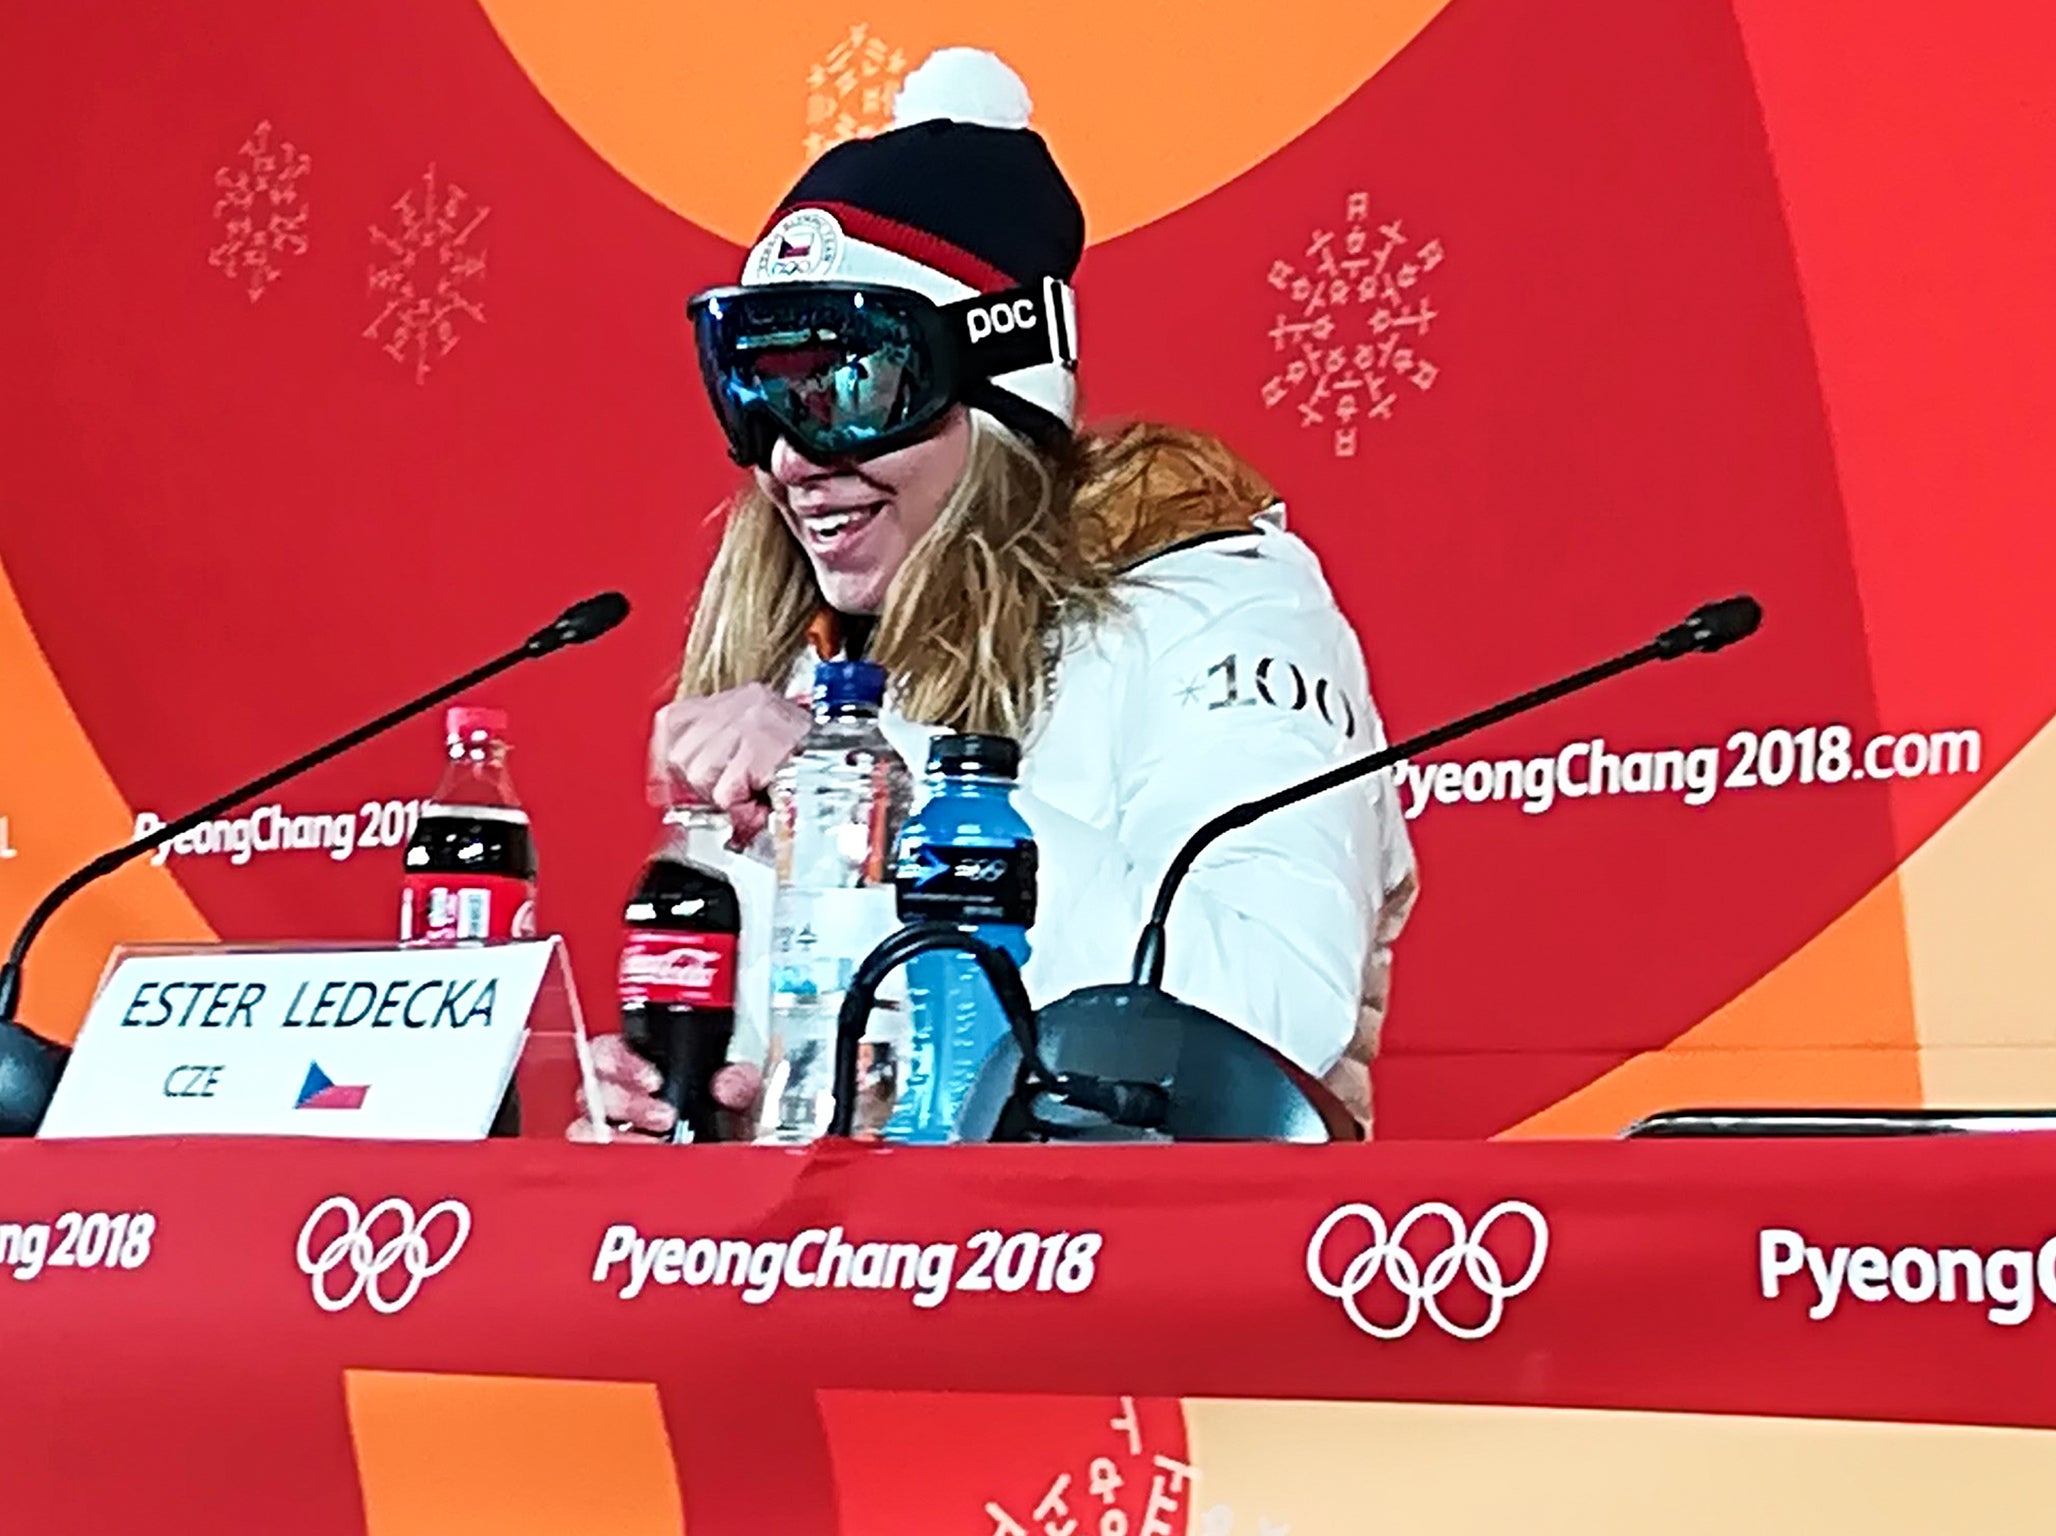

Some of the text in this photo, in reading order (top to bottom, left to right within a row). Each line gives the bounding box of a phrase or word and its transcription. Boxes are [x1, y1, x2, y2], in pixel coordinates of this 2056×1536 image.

[1724, 725, 1980, 788] 2018.com
[357, 799, 438, 848] 201
[121, 978, 499, 1028] ESTER LEDECKA
[162, 1065, 226, 1097] CZE
[47, 1211, 156, 1269] 2018
[593, 1225, 1102, 1307] PyeongChang 2018
